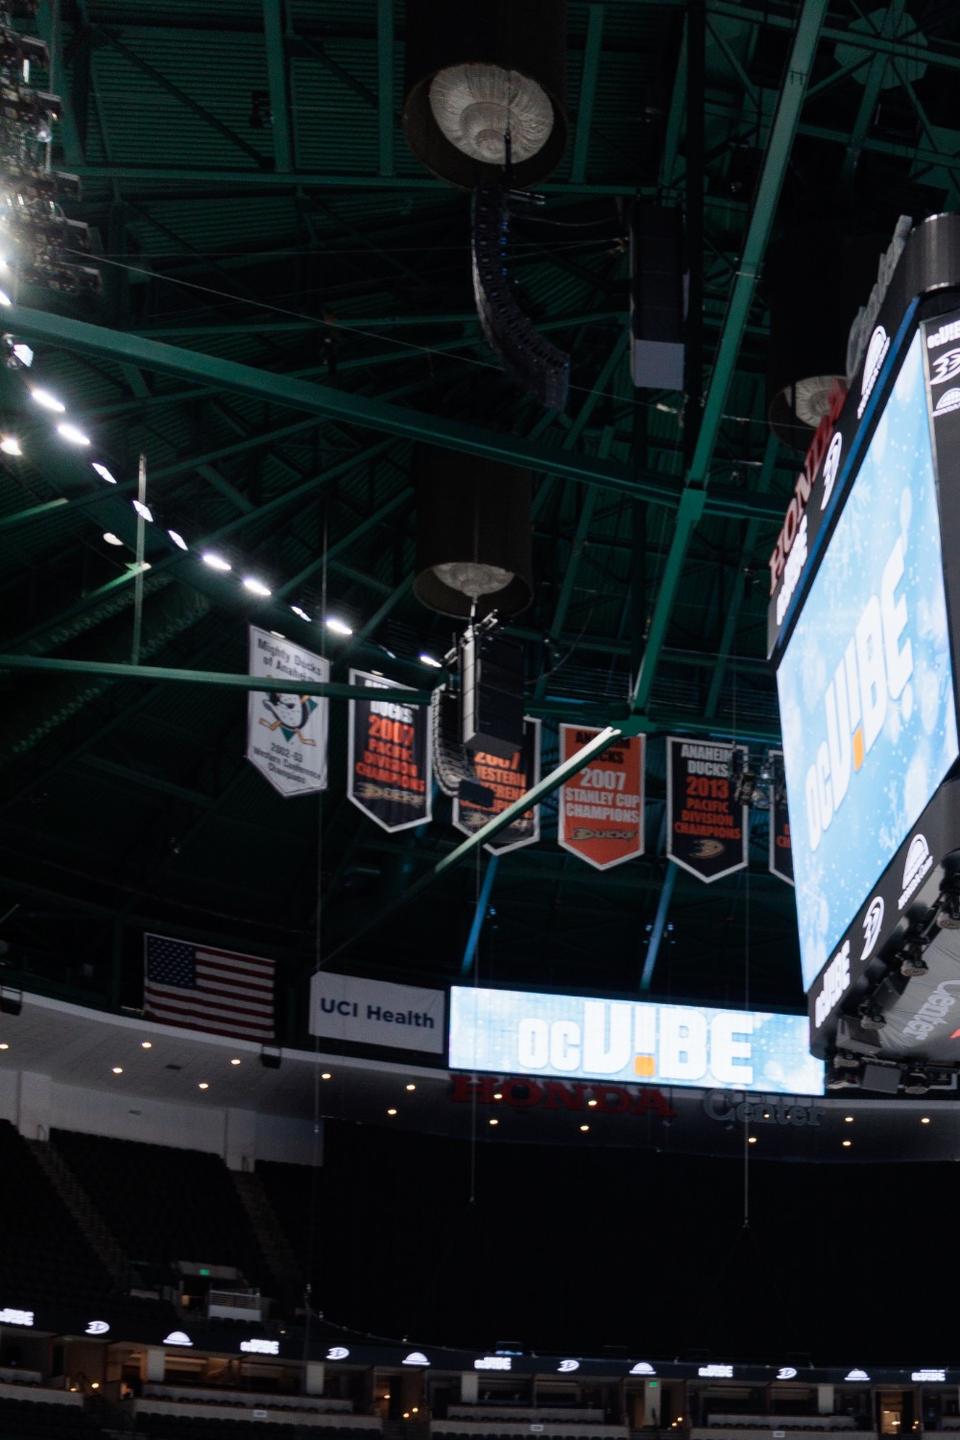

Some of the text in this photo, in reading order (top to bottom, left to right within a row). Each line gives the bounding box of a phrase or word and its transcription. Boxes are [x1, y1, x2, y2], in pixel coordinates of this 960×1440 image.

[579, 767, 627, 791] 2007
[687, 760, 729, 778] DUCKS
[566, 786, 641, 809] STANLEY CUP
[686, 776, 730, 800] 2013
[566, 802, 640, 824] CHAMPIONS
[686, 797, 730, 814] PACIFIC
[681, 809, 734, 827] DIVISION
[674, 821, 742, 840] CHAMPIONS
[321, 998, 434, 1029] UCI Health
[451, 1073, 826, 1127] HONDA Center
